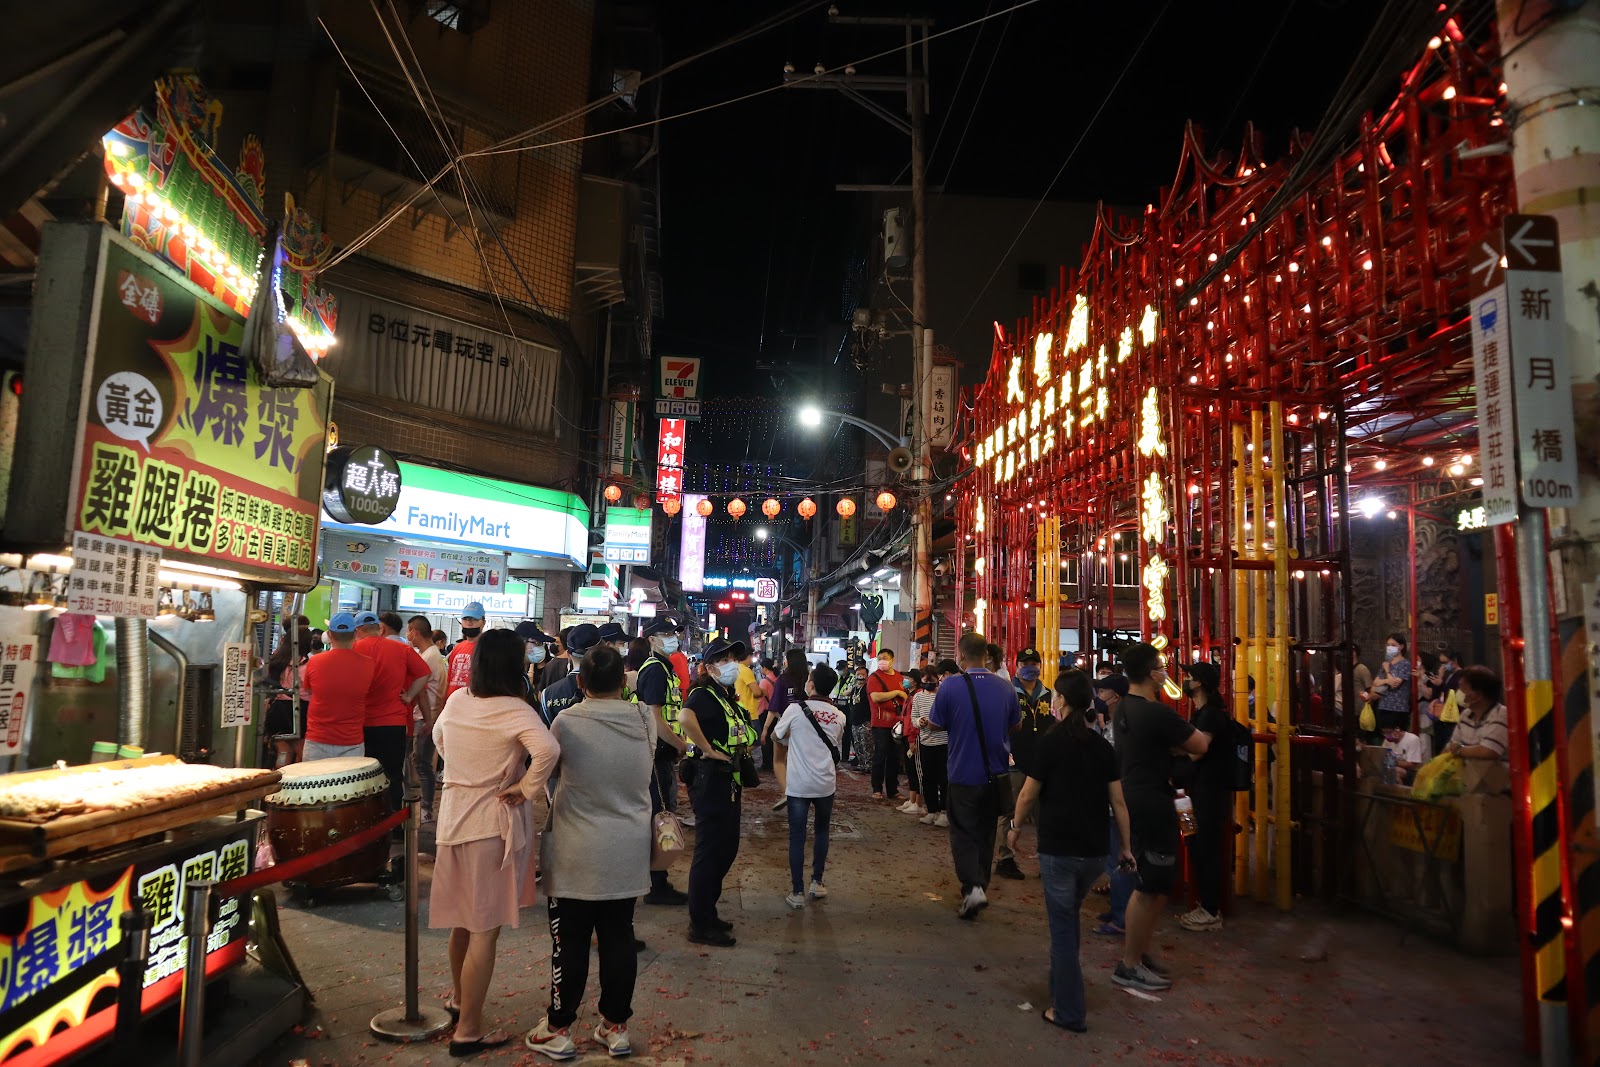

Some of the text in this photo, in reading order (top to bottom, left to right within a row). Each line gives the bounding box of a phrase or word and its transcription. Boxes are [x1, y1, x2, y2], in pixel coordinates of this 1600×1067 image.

[1520, 287, 1563, 463] 新月橋
[105, 382, 155, 428] 黃金
[191, 334, 299, 474] 爆漿
[1483, 341, 1505, 489] 捷運新莊站
[659, 418, 682, 503] 和銀樓
[85, 447, 218, 551] 雞腿捲
[1529, 479, 1572, 498] 100m
[222, 488, 313, 543] 採用鮮嫩雞皮包覆
[350, 495, 390, 516] 1000cc
[1487, 498, 1513, 517] 500m
[408, 505, 511, 539] FamilyMart
[608, 529, 648, 540] FamilyMart
[217, 523, 310, 570] 多汁去骨雞腿肉
[622, 550, 632, 559] ATM
[86, 539, 102, 591] 雞腿串
[334, 560, 378, 573] 全家 健康
[96, 598, 123, 613] 三支100
[437, 593, 513, 611] FamilyMart
[1487, 594, 1496, 622] 出口
[6, 644, 33, 661] 特價
[219, 898, 239, 917] rolls
